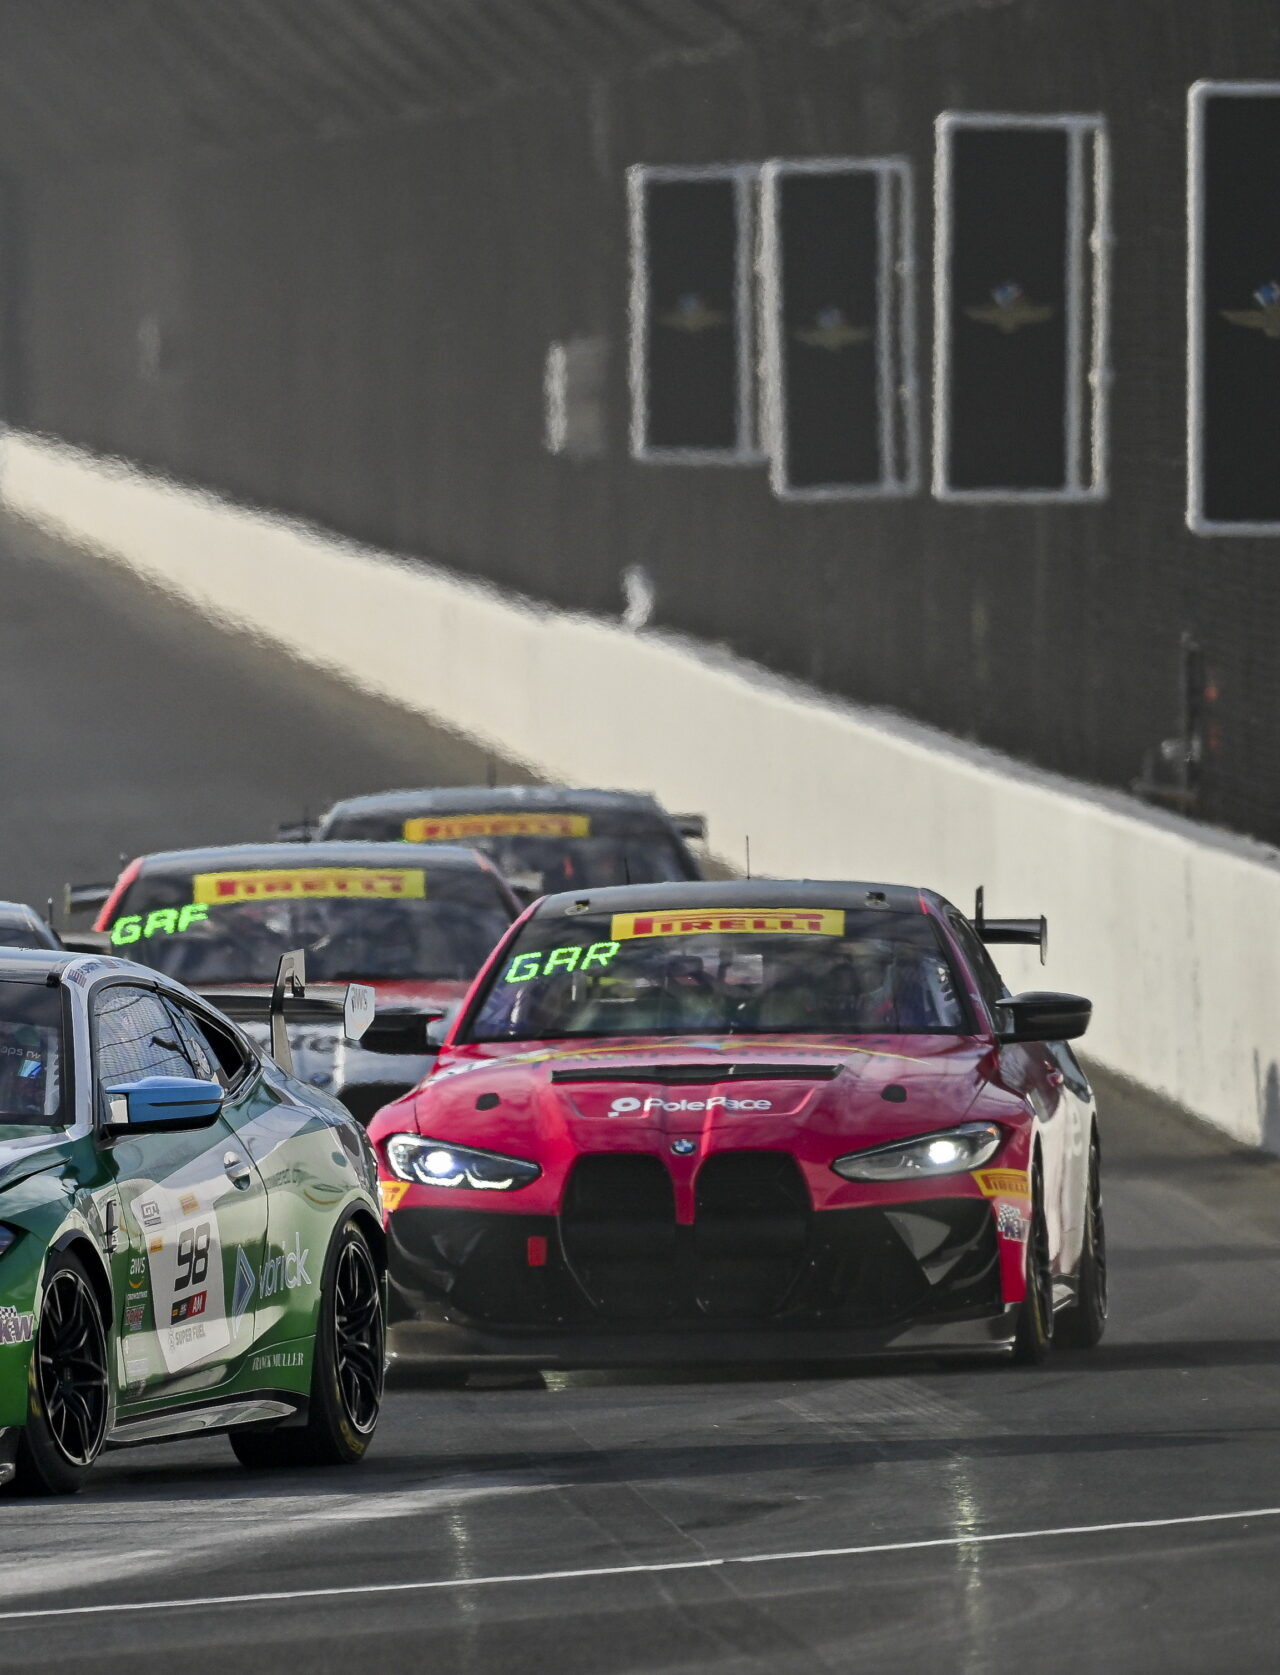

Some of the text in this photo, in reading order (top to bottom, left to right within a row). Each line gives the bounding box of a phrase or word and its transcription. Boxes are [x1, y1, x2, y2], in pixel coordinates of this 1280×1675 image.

[633, 911, 824, 935] PIRELLI
[505, 942, 620, 983] GAR
[130, 1256, 146, 1275] aws
[174, 1222, 210, 1292] 98
[259, 1231, 312, 1300] vbrick
